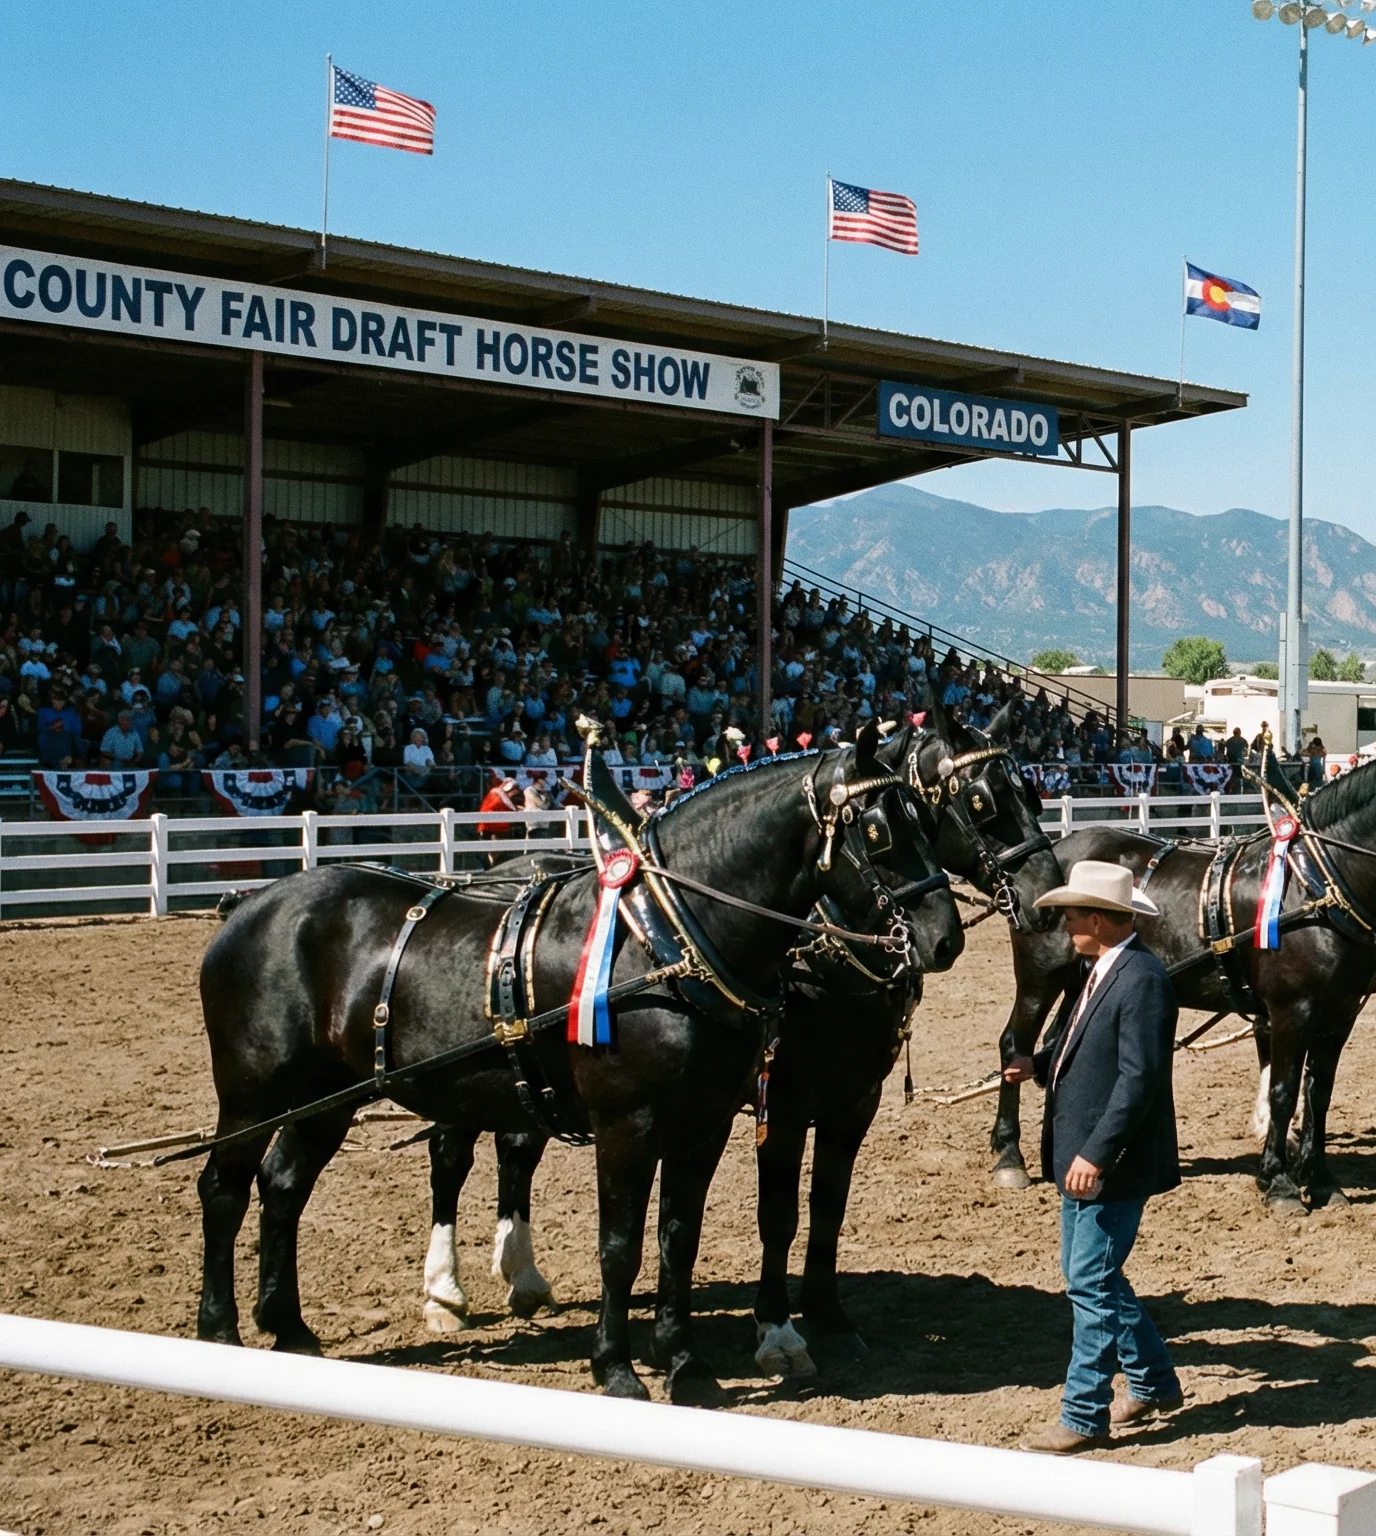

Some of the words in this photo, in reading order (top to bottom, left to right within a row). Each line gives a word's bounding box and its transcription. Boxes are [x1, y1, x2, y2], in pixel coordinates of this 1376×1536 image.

[4, 259, 207, 332] COUNTY
[221, 291, 317, 347] FAIR
[332, 307, 463, 367] DRAFT
[477, 328, 600, 386] HORSE
[611, 349, 711, 401] SHOW
[889, 393, 1049, 447] COLORADO
